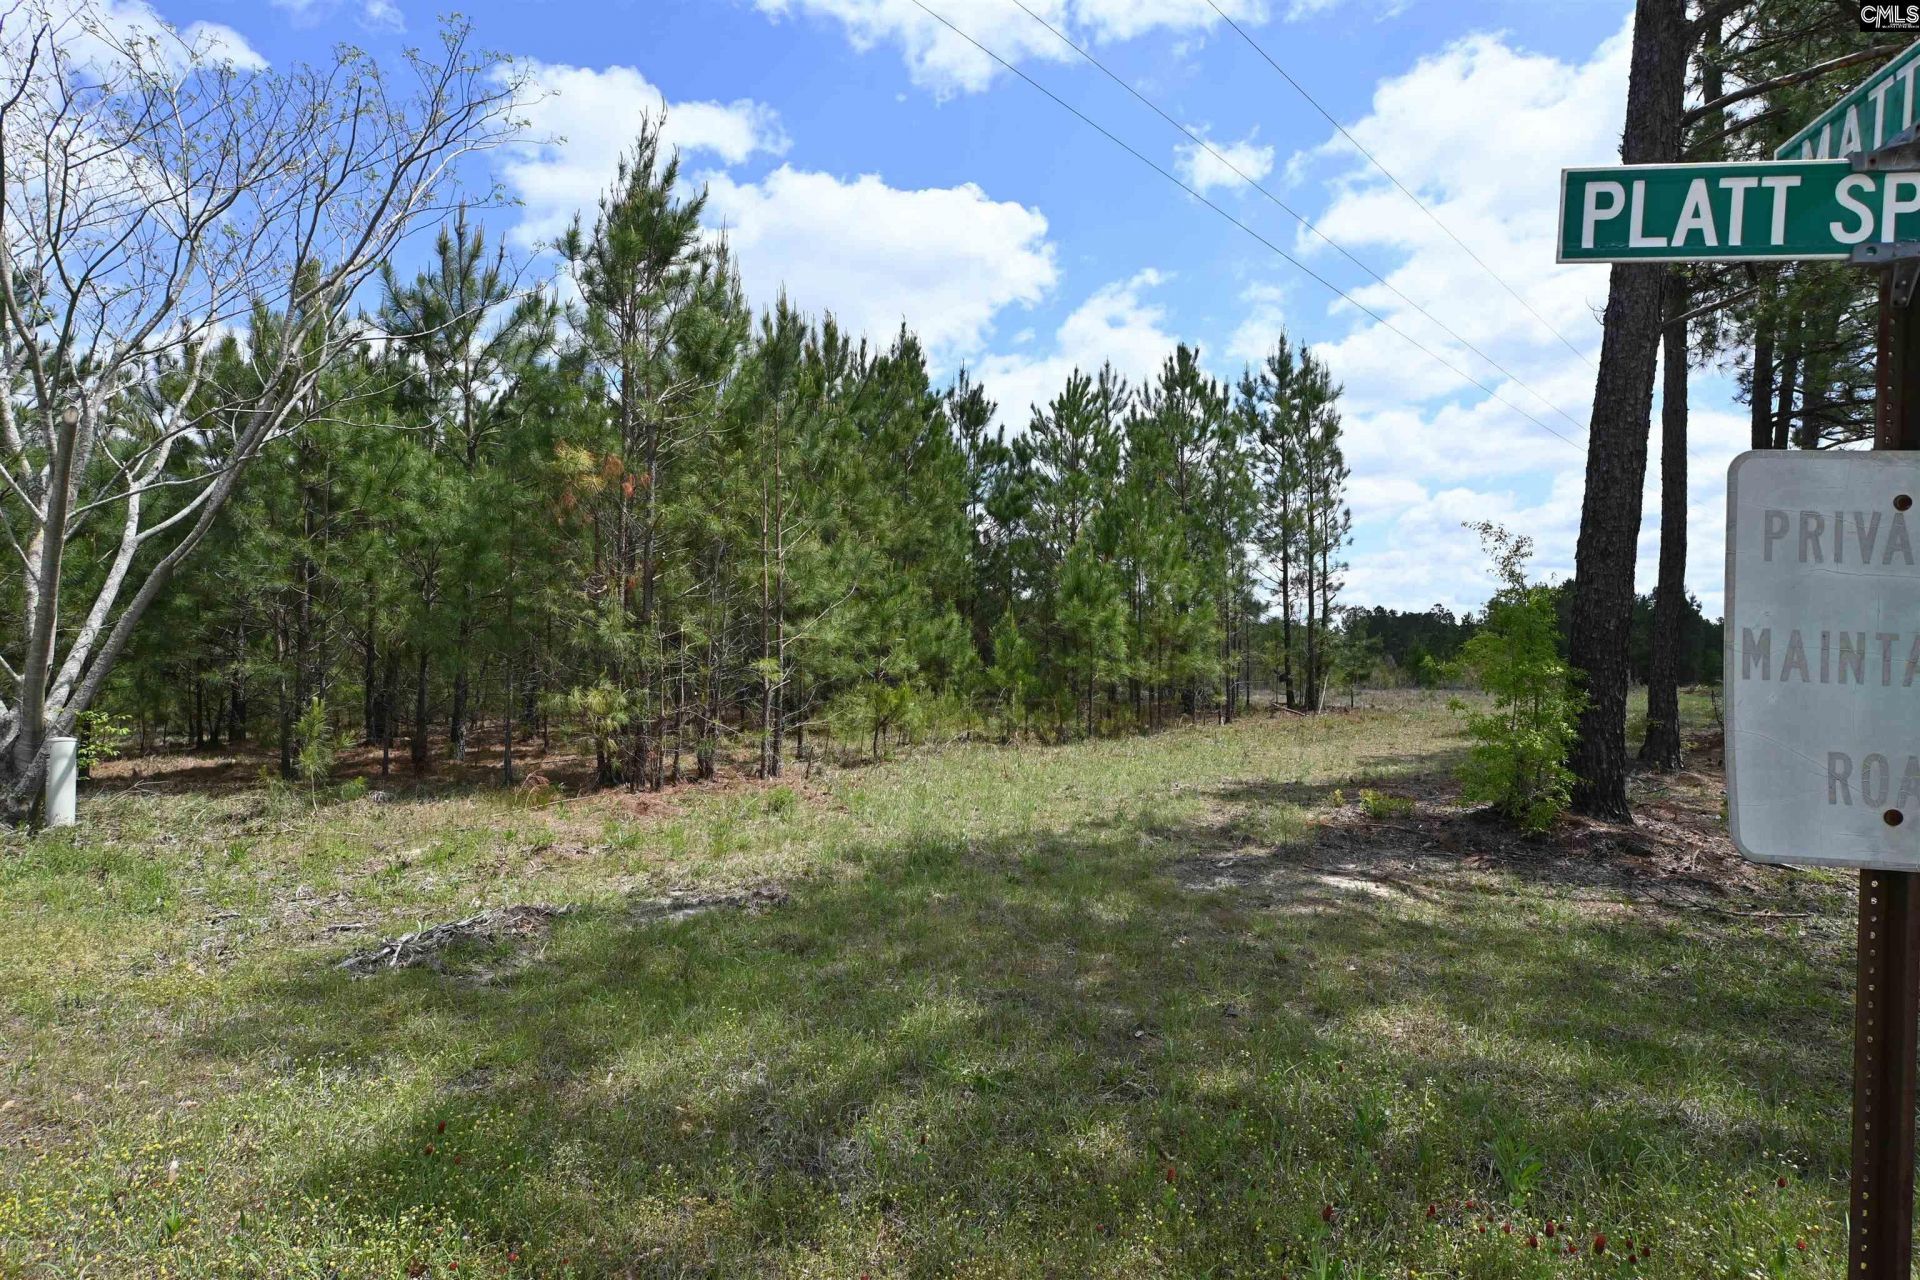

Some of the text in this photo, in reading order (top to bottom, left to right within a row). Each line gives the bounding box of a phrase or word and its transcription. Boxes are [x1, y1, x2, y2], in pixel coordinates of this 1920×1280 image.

[1580, 173, 1920, 249] PLATT SP
[1763, 509, 1914, 565] PRIVA
[1827, 751, 1920, 808] ROA
